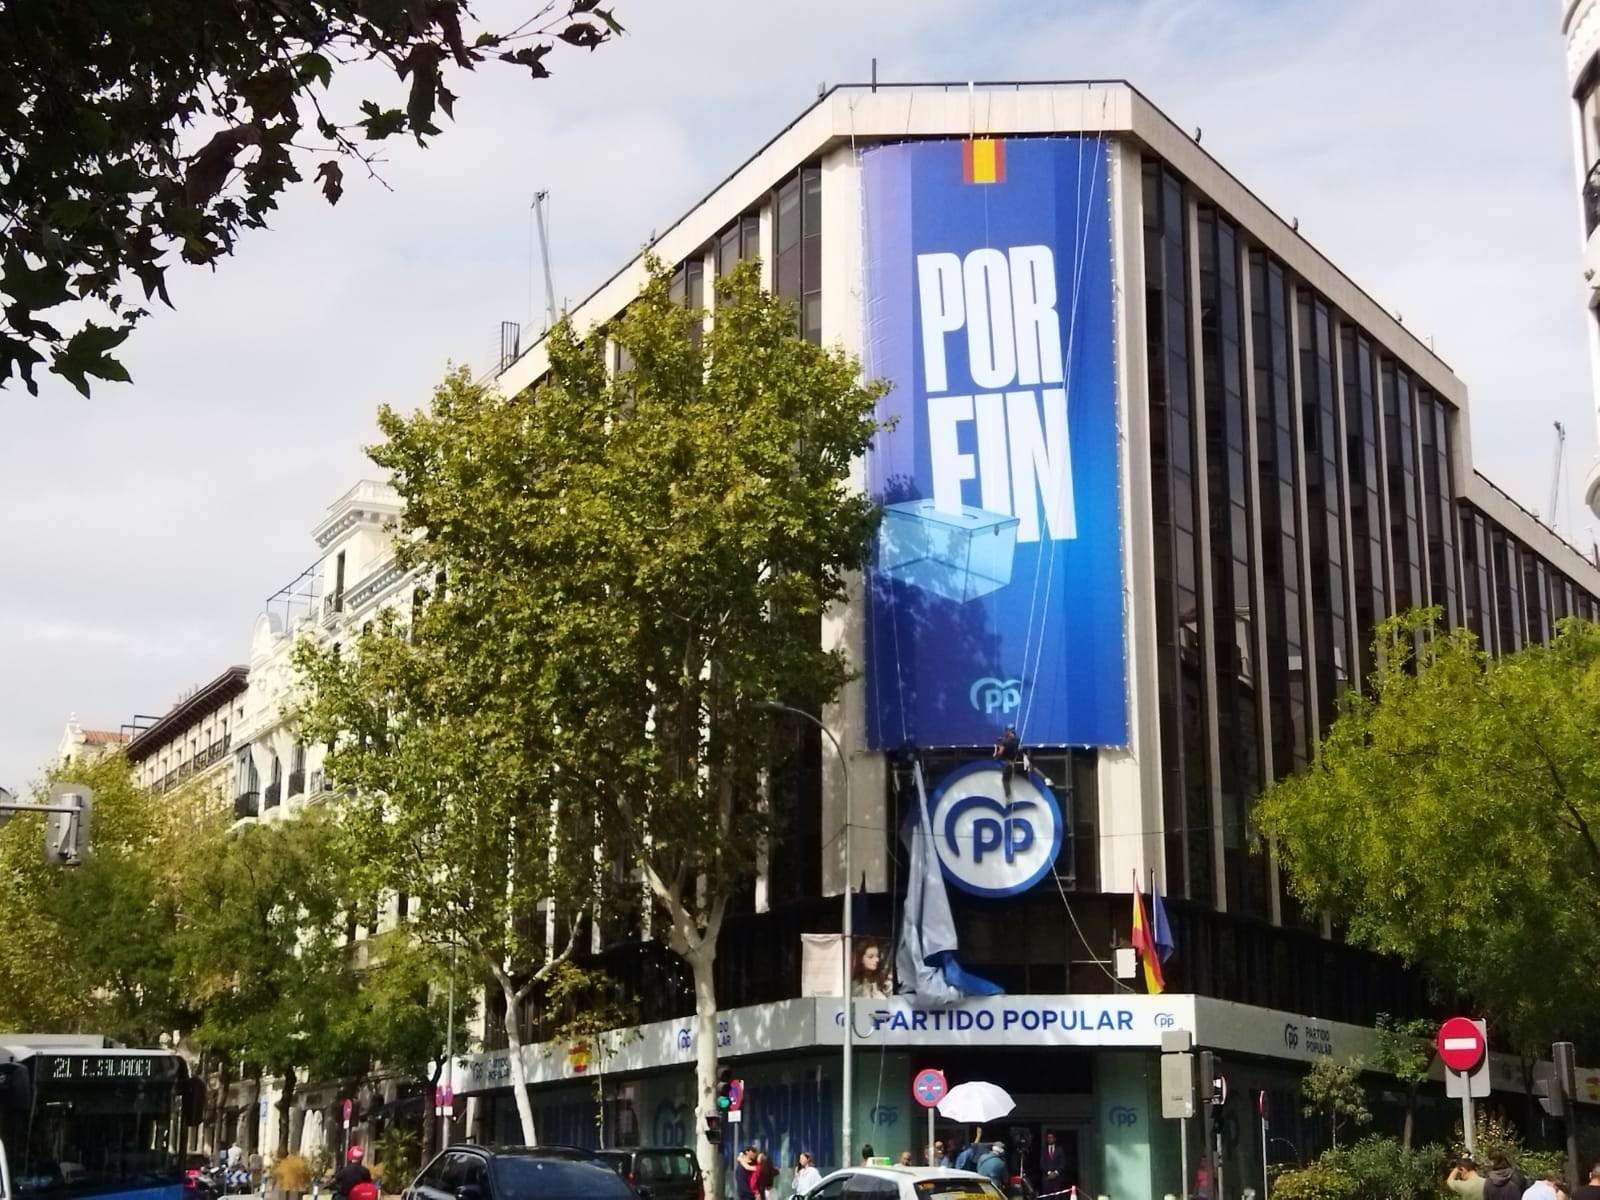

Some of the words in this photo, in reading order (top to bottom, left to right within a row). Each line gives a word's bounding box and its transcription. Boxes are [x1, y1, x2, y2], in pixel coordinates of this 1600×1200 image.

[917, 244, 1063, 393] POR
[927, 387, 1078, 543] FIN
[873, 1009, 995, 1032] PARTIDO
[1003, 1009, 1134, 1032] POPULAR
